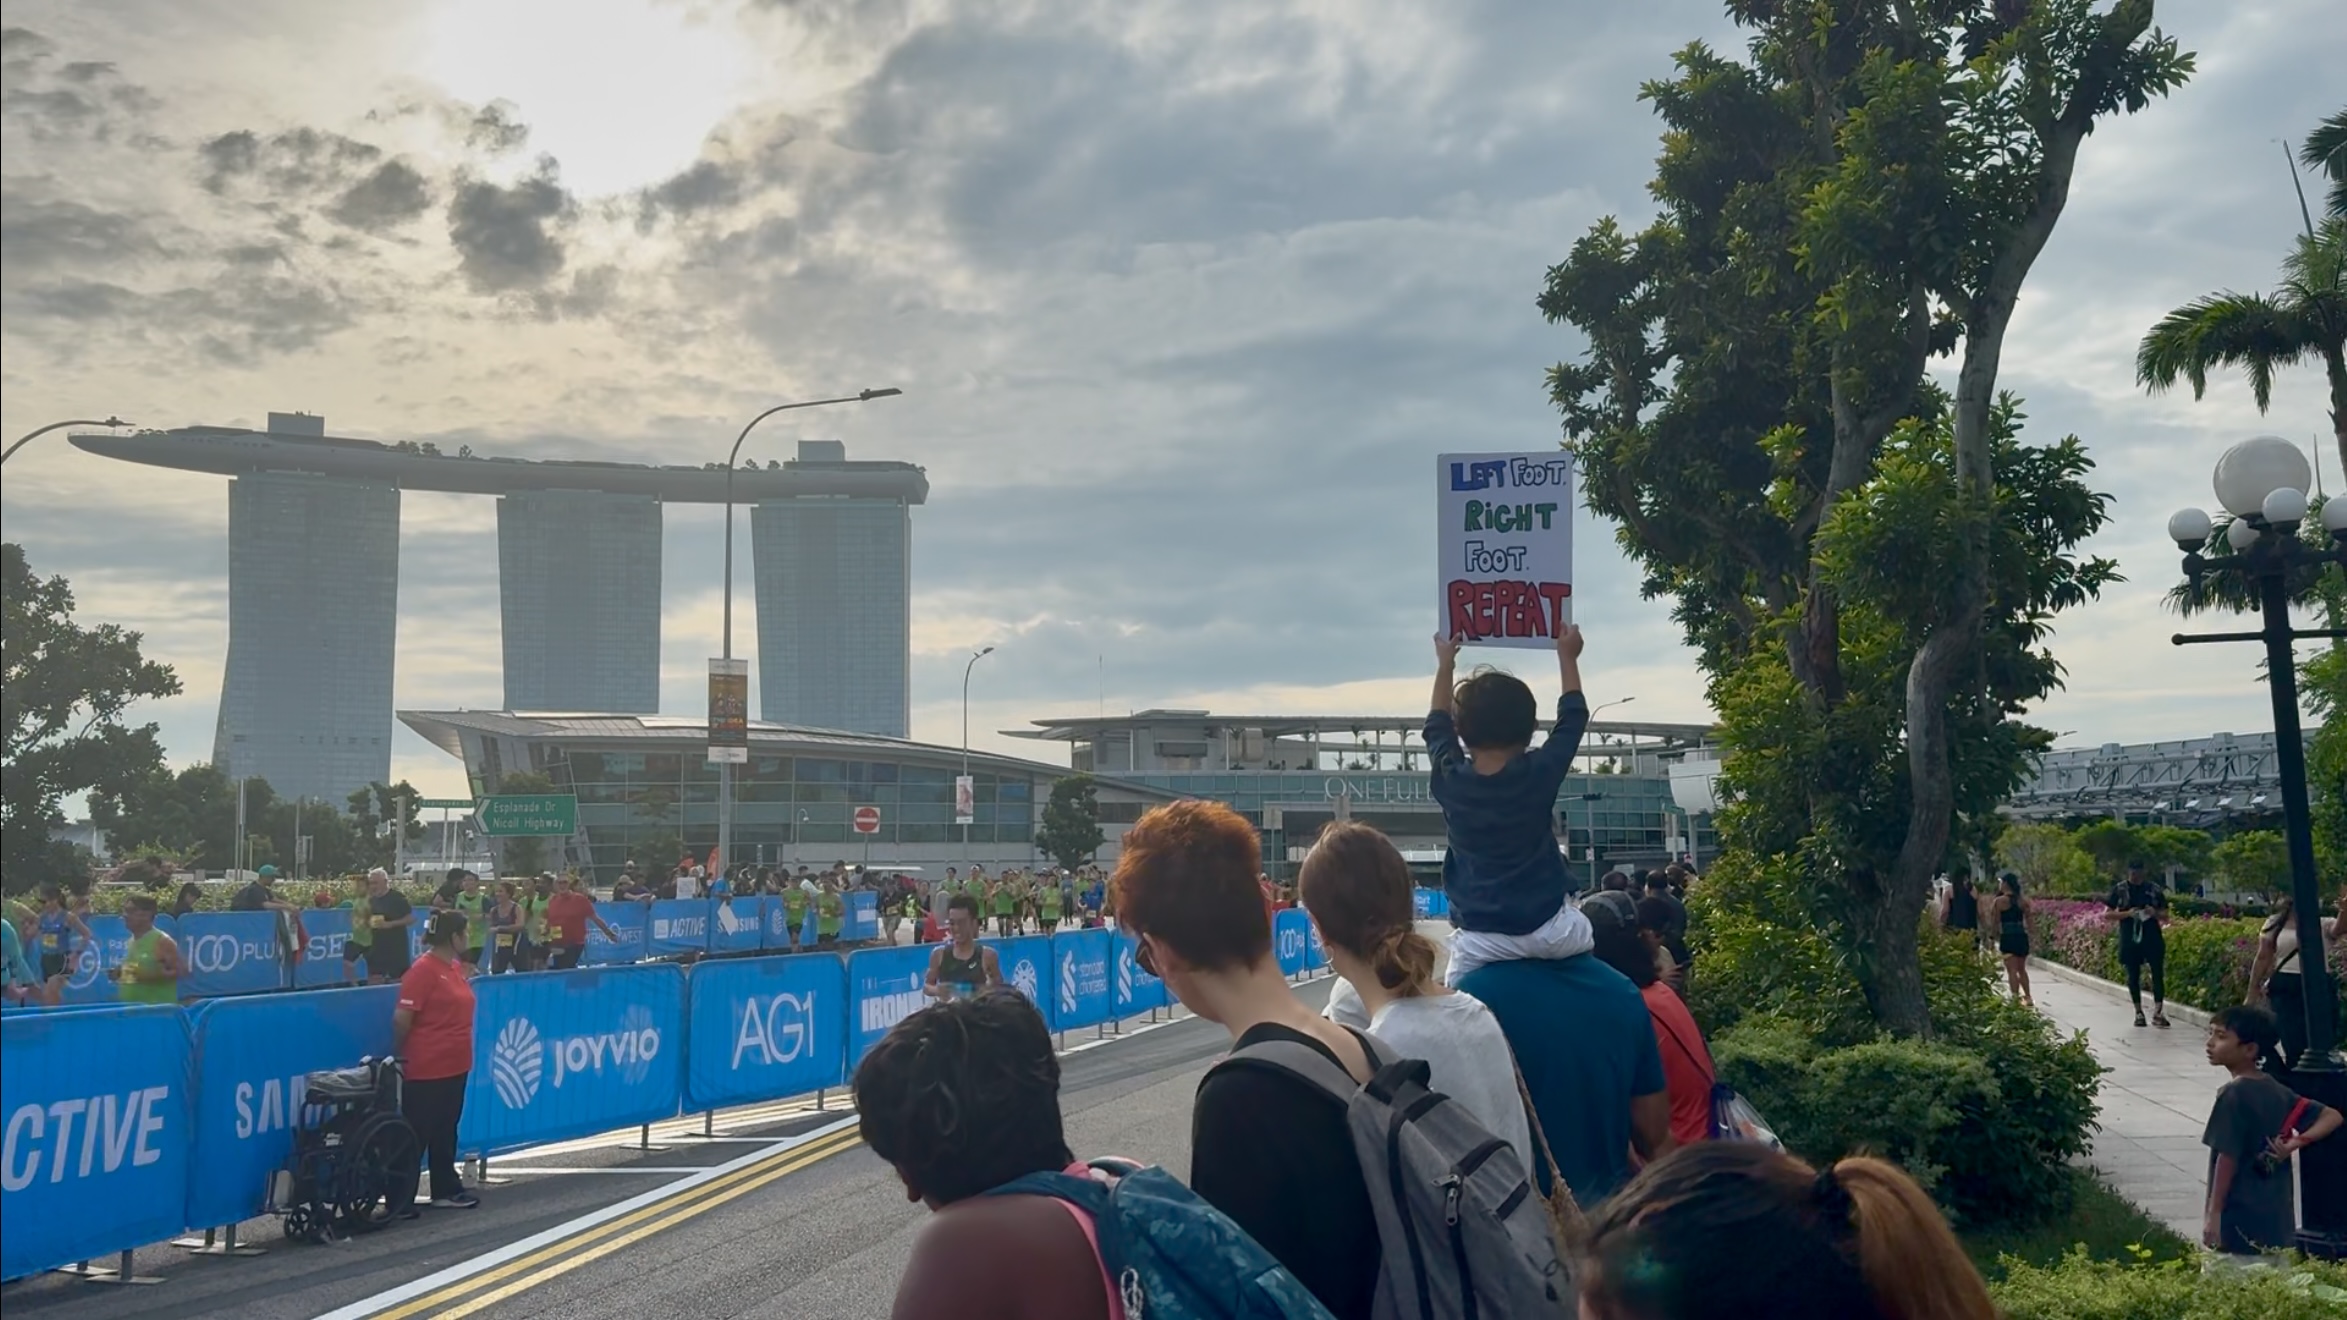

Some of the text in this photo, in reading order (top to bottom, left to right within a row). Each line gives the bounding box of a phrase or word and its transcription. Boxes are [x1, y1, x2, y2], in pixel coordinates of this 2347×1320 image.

[1450, 460, 1506, 491] LEFT
[1447, 579, 1571, 642] REPEAT
[1325, 777, 1376, 799] ONE
[493, 801, 556, 814] Esplanade Dr
[493, 818, 565, 831] Nicoll Highway
[670, 916, 706, 937] ACTIVE
[717, 916, 760, 933] SSUNG
[186, 934, 276, 973] 100 PLU
[731, 990, 814, 1071] AG1
[553, 1028, 660, 1089] JOYVIO
[1, 1085, 169, 1192] CTIVE
